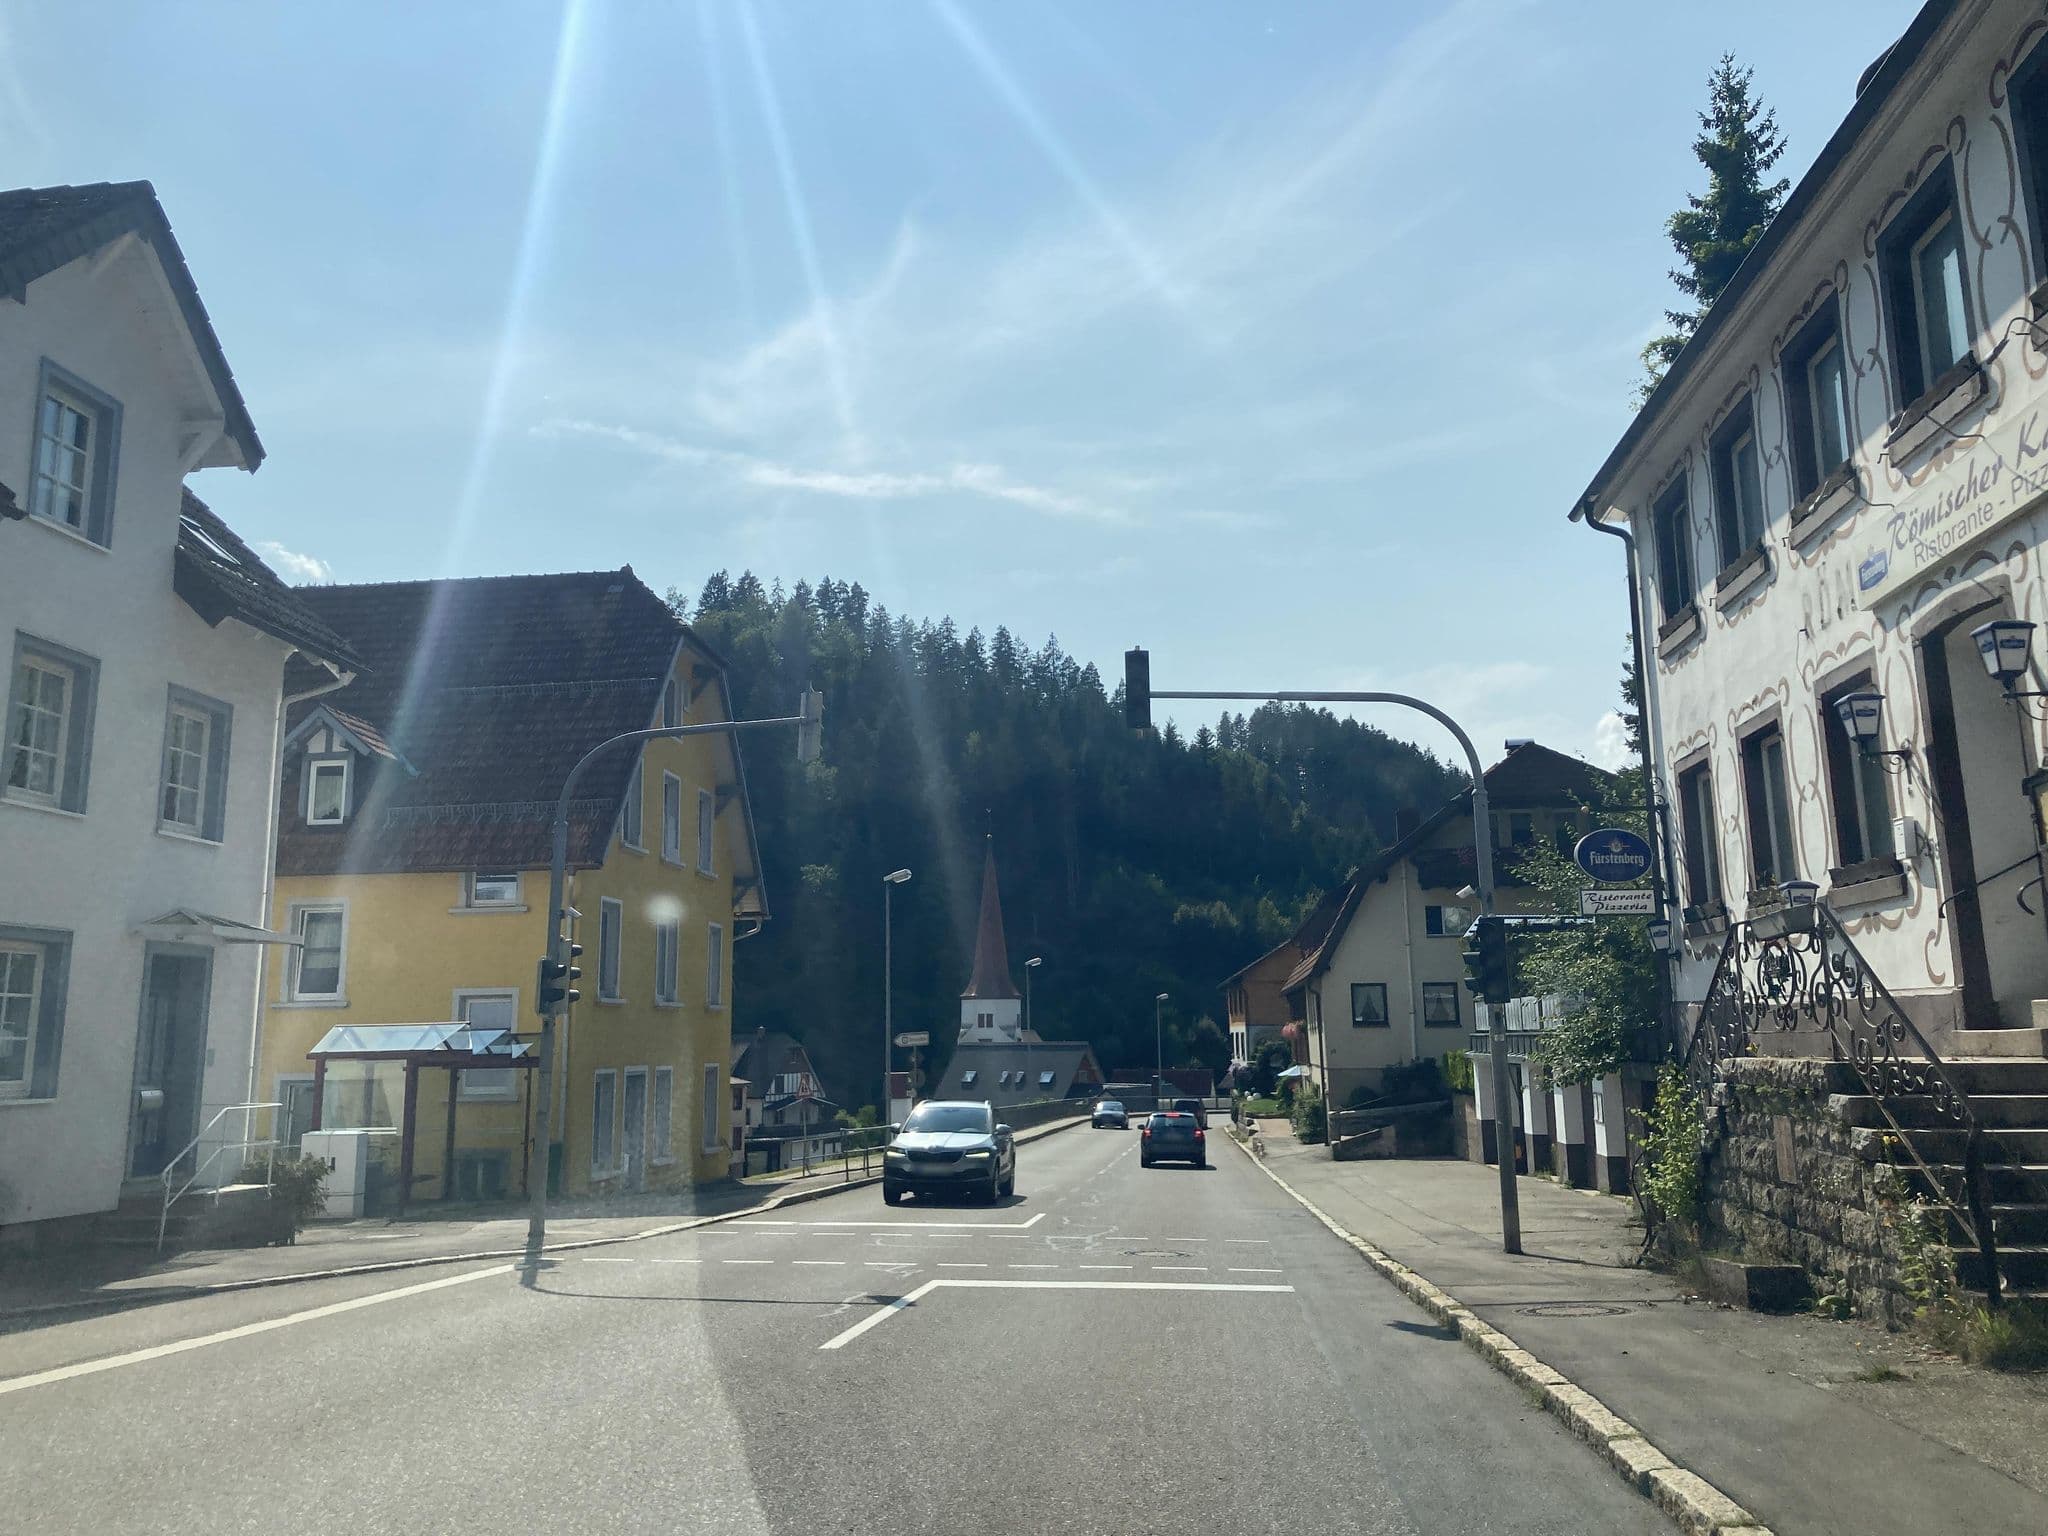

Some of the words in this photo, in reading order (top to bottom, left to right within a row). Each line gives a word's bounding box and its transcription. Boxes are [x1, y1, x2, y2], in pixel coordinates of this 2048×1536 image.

[1887, 455, 2003, 567] Römischer
[1913, 502, 1994, 569] Ristorante
[1589, 851, 1645, 867] Fürstenberg
[1584, 892, 1653, 903] Ristorante
[1591, 901, 1648, 914] Pizzeria
